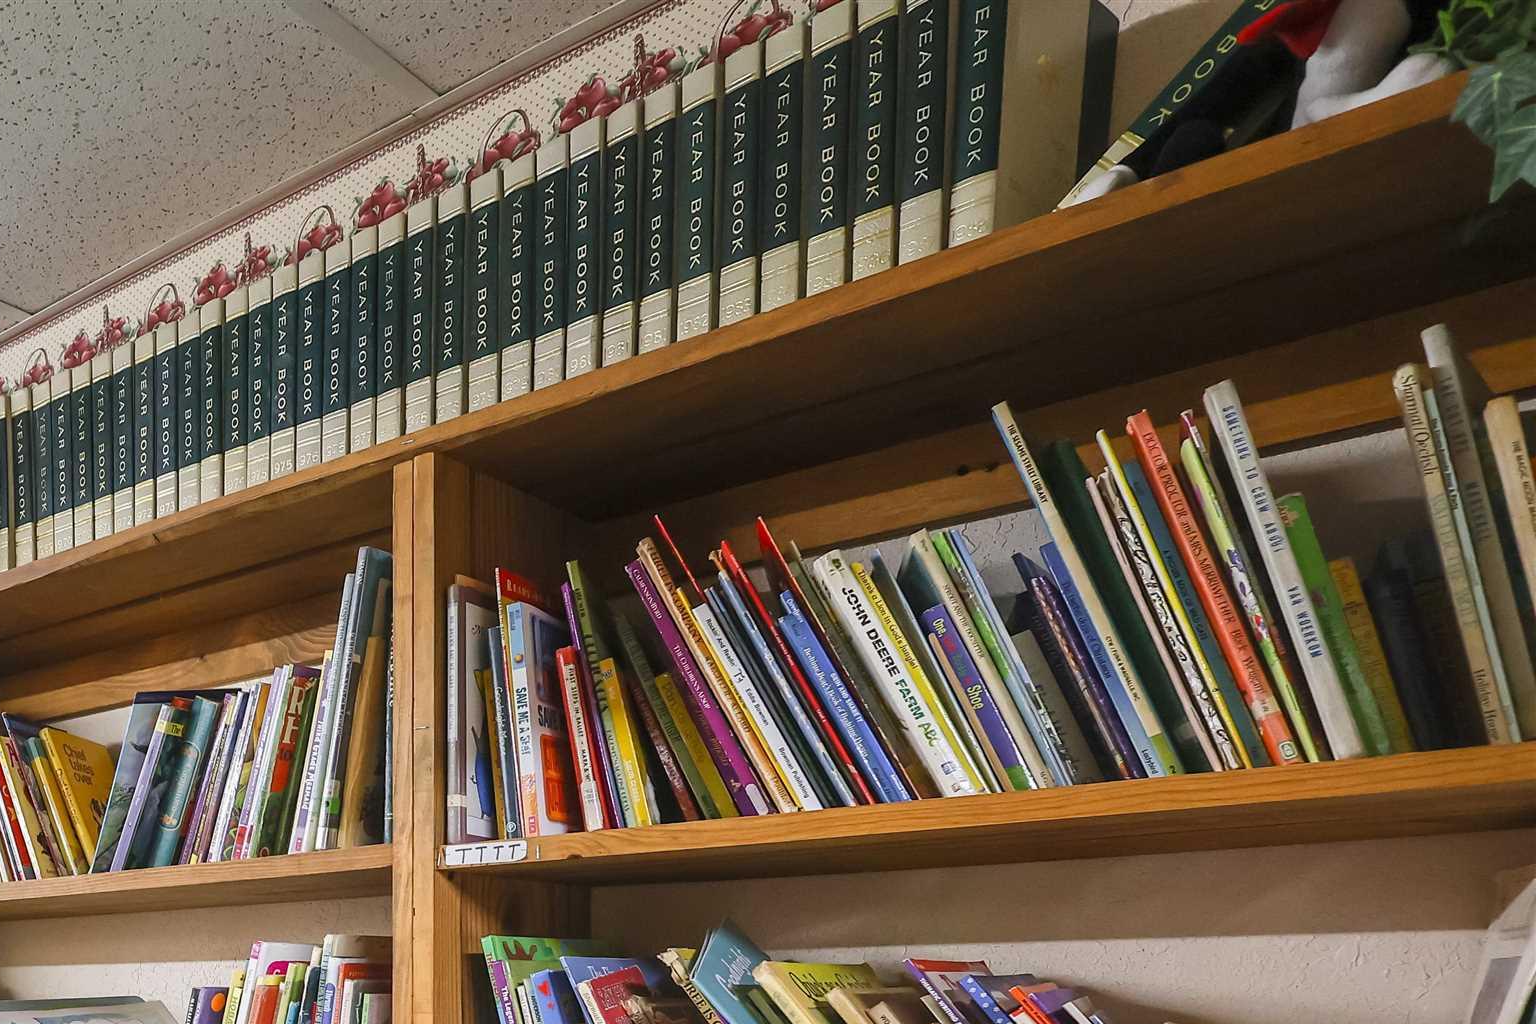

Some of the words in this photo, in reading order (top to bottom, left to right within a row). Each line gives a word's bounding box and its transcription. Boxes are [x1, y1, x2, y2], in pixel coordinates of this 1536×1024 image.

[869, 30, 884, 107] YEAR
[917, 10, 933, 88] YEAR
[1149, 34, 1237, 126] BOOK
[822, 57, 837, 130] YEAR
[967, 84, 986, 167] BOOK
[691, 112, 704, 183] YEAR
[733, 94, 746, 166] YEAR
[865, 124, 880, 202] BOOK
[913, 105, 929, 186] BOOK
[577, 164, 588, 231] YEAR
[613, 147, 626, 215] YEAR
[819, 146, 834, 223] BOOK
[477, 213, 488, 274] YEAR
[688, 198, 702, 269] BOOK
[731, 181, 745, 254] BOOK
[414, 240, 423, 299] YEAR
[576, 245, 587, 312] BOOK
[612, 231, 624, 297] BOOK
[304, 291, 312, 345] YEAR
[413, 313, 421, 371] BOOK
[477, 288, 486, 350] BOOK
[1006, 423, 1017, 436] THE
[1011, 434, 1027, 457] SESAME
[1021, 456, 1037, 478] STREET
[1030, 477, 1048, 504] LIBRARY
[1222, 405, 1251, 460] SOMETHING
[1244, 466, 1258, 480] TO
[1251, 485, 1271, 514] CROW
[1262, 520, 1285, 554] ABOUT
[855, 568, 876, 594] There's
[873, 598, 888, 615] Lion
[886, 621, 905, 645] God's
[515, 686, 527, 708] SAVE
[839, 583, 872, 627] JOHN
[863, 626, 902, 678] DEERE
[893, 676, 926, 720] FARM
[918, 720, 941, 747] ABC
[963, 682, 989, 711] Shoe
[517, 710, 529, 724] ME
[777, 746, 795, 770] Bowman
[789, 769, 810, 798] Publishing
[500, 986, 509, 1001] The
